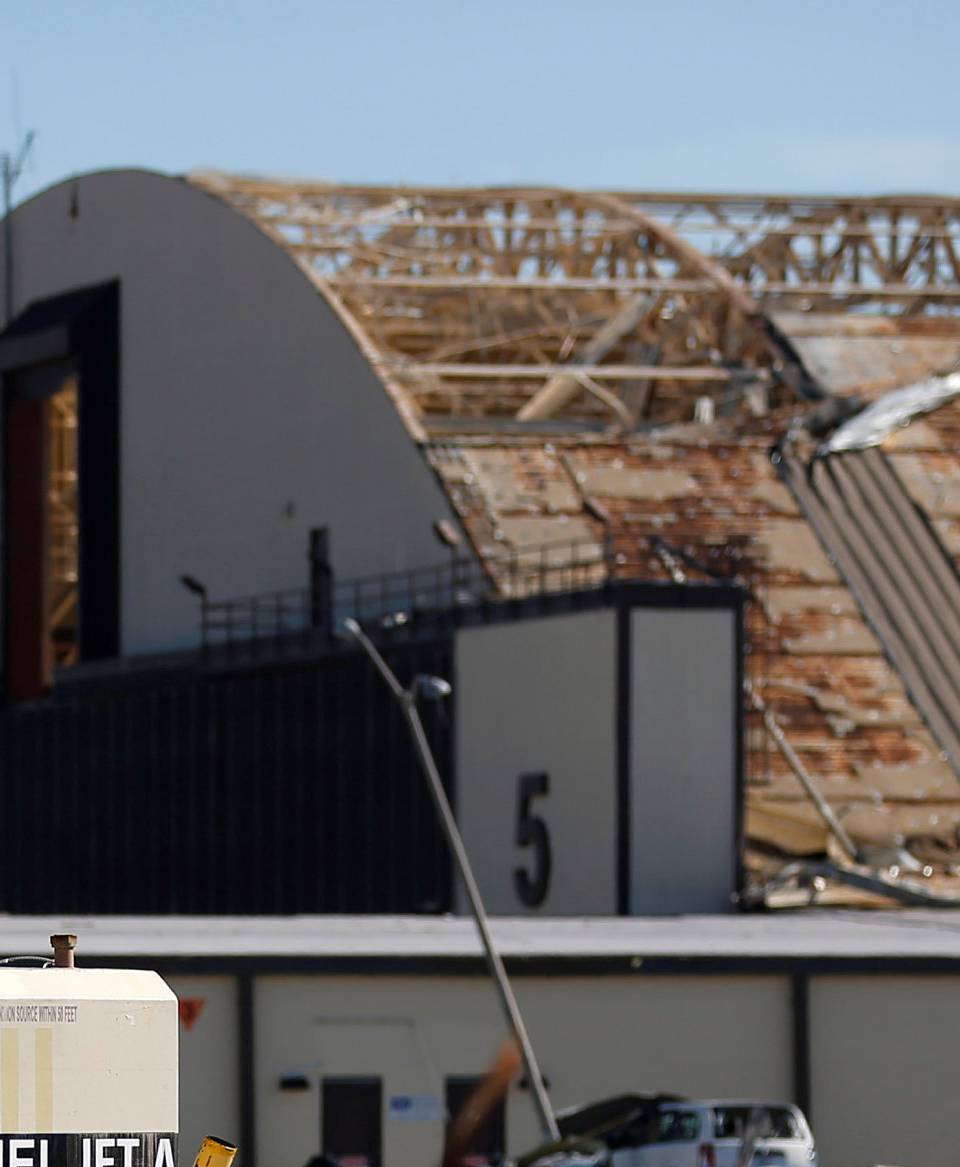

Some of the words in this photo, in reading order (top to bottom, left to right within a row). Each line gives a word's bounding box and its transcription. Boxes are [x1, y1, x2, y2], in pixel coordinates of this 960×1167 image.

[513, 772, 551, 909] 5
[16, 1006, 37, 1021] SOURCE
[38, 1006, 56, 1021] WITHIN
[64, 1006, 77, 1021] FEET
